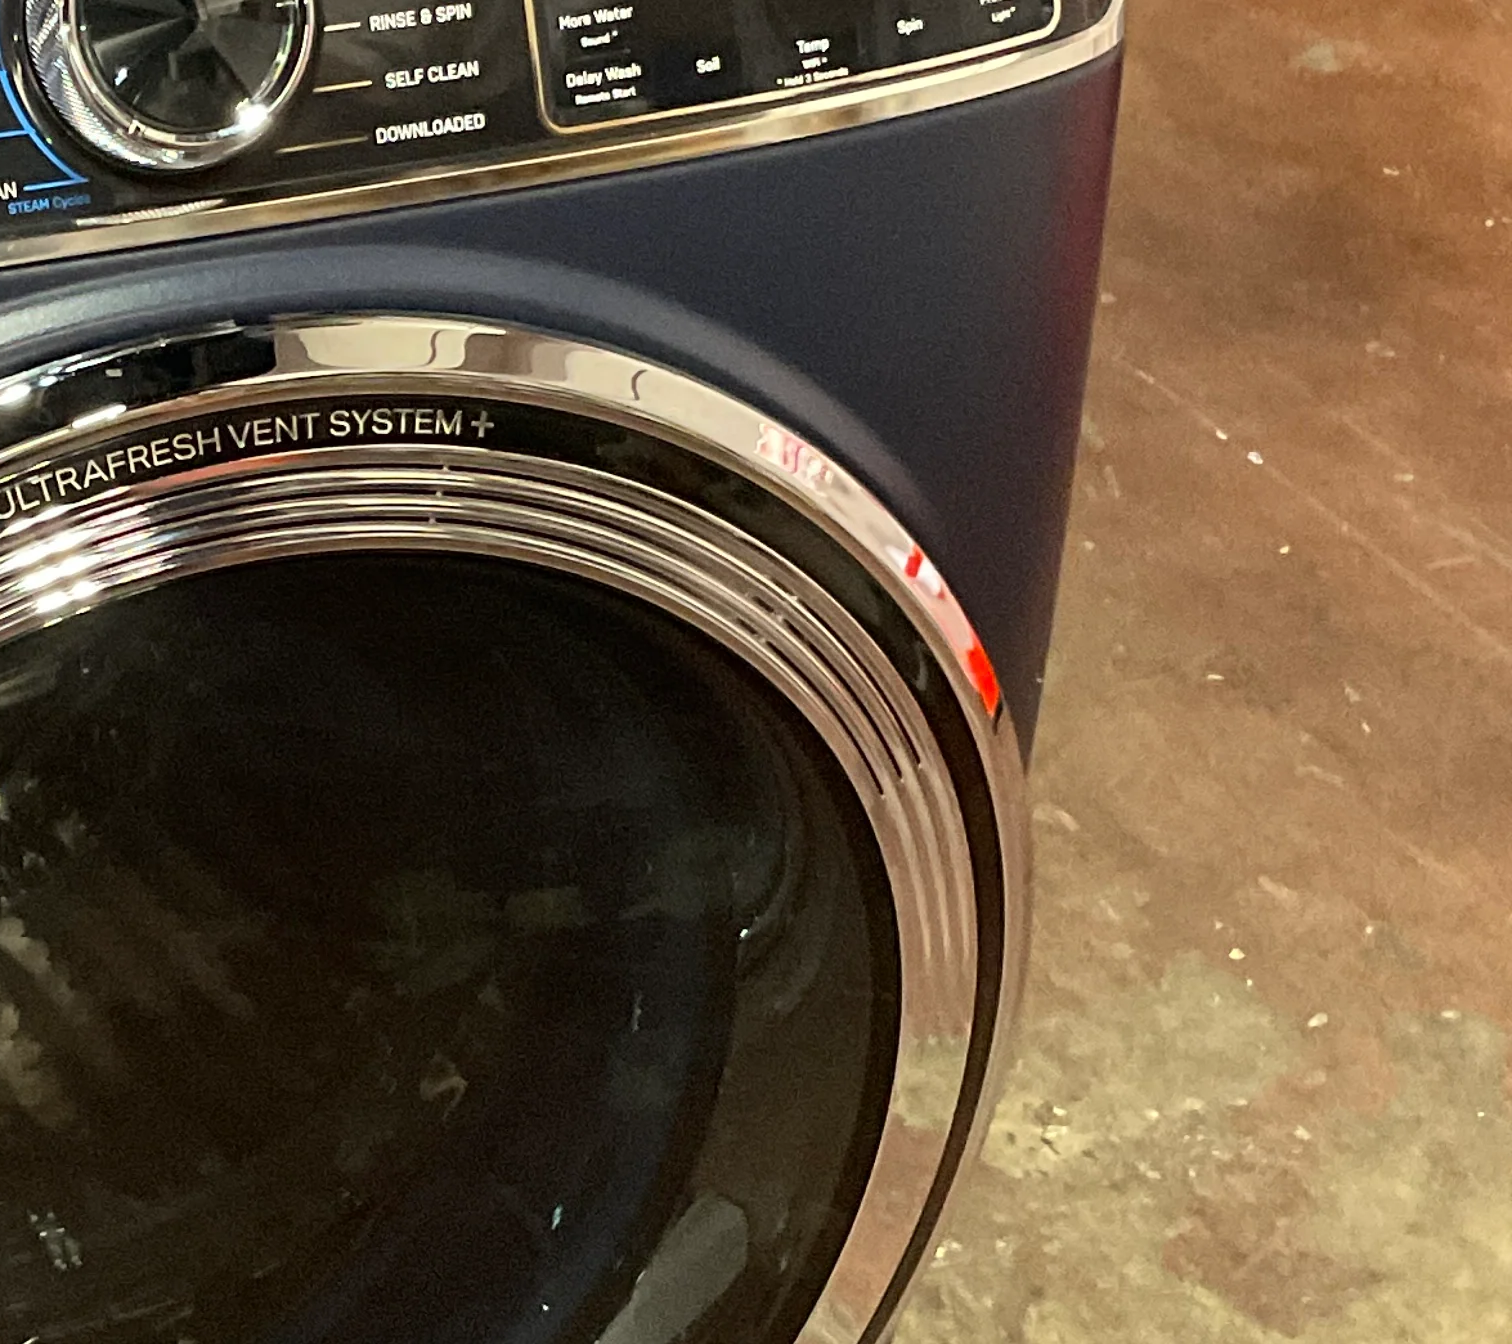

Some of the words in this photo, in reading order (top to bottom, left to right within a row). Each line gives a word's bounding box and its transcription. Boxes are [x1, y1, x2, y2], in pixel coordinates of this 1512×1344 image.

[369, 10, 417, 32] RINSE
[420, 8, 433, 25] &
[435, 2, 472, 23] SPIN
[558, 14, 591, 30] More
[593, 6, 633, 24] Water
[896, 17, 924, 35] Spin
[385, 67, 424, 89] SELF
[427, 60, 480, 83] CLEAN
[565, 70, 603, 89] Delay
[605, 62, 642, 81] Wash
[695, 55, 721, 74] Soil
[375, 113, 486, 144] DOWNLOADED
[7, 197, 50, 215] STEAM
[227, 412, 320, 449] VENT
[329, 408, 463, 437] SYSTEM
[470, 410, 495, 439] +
